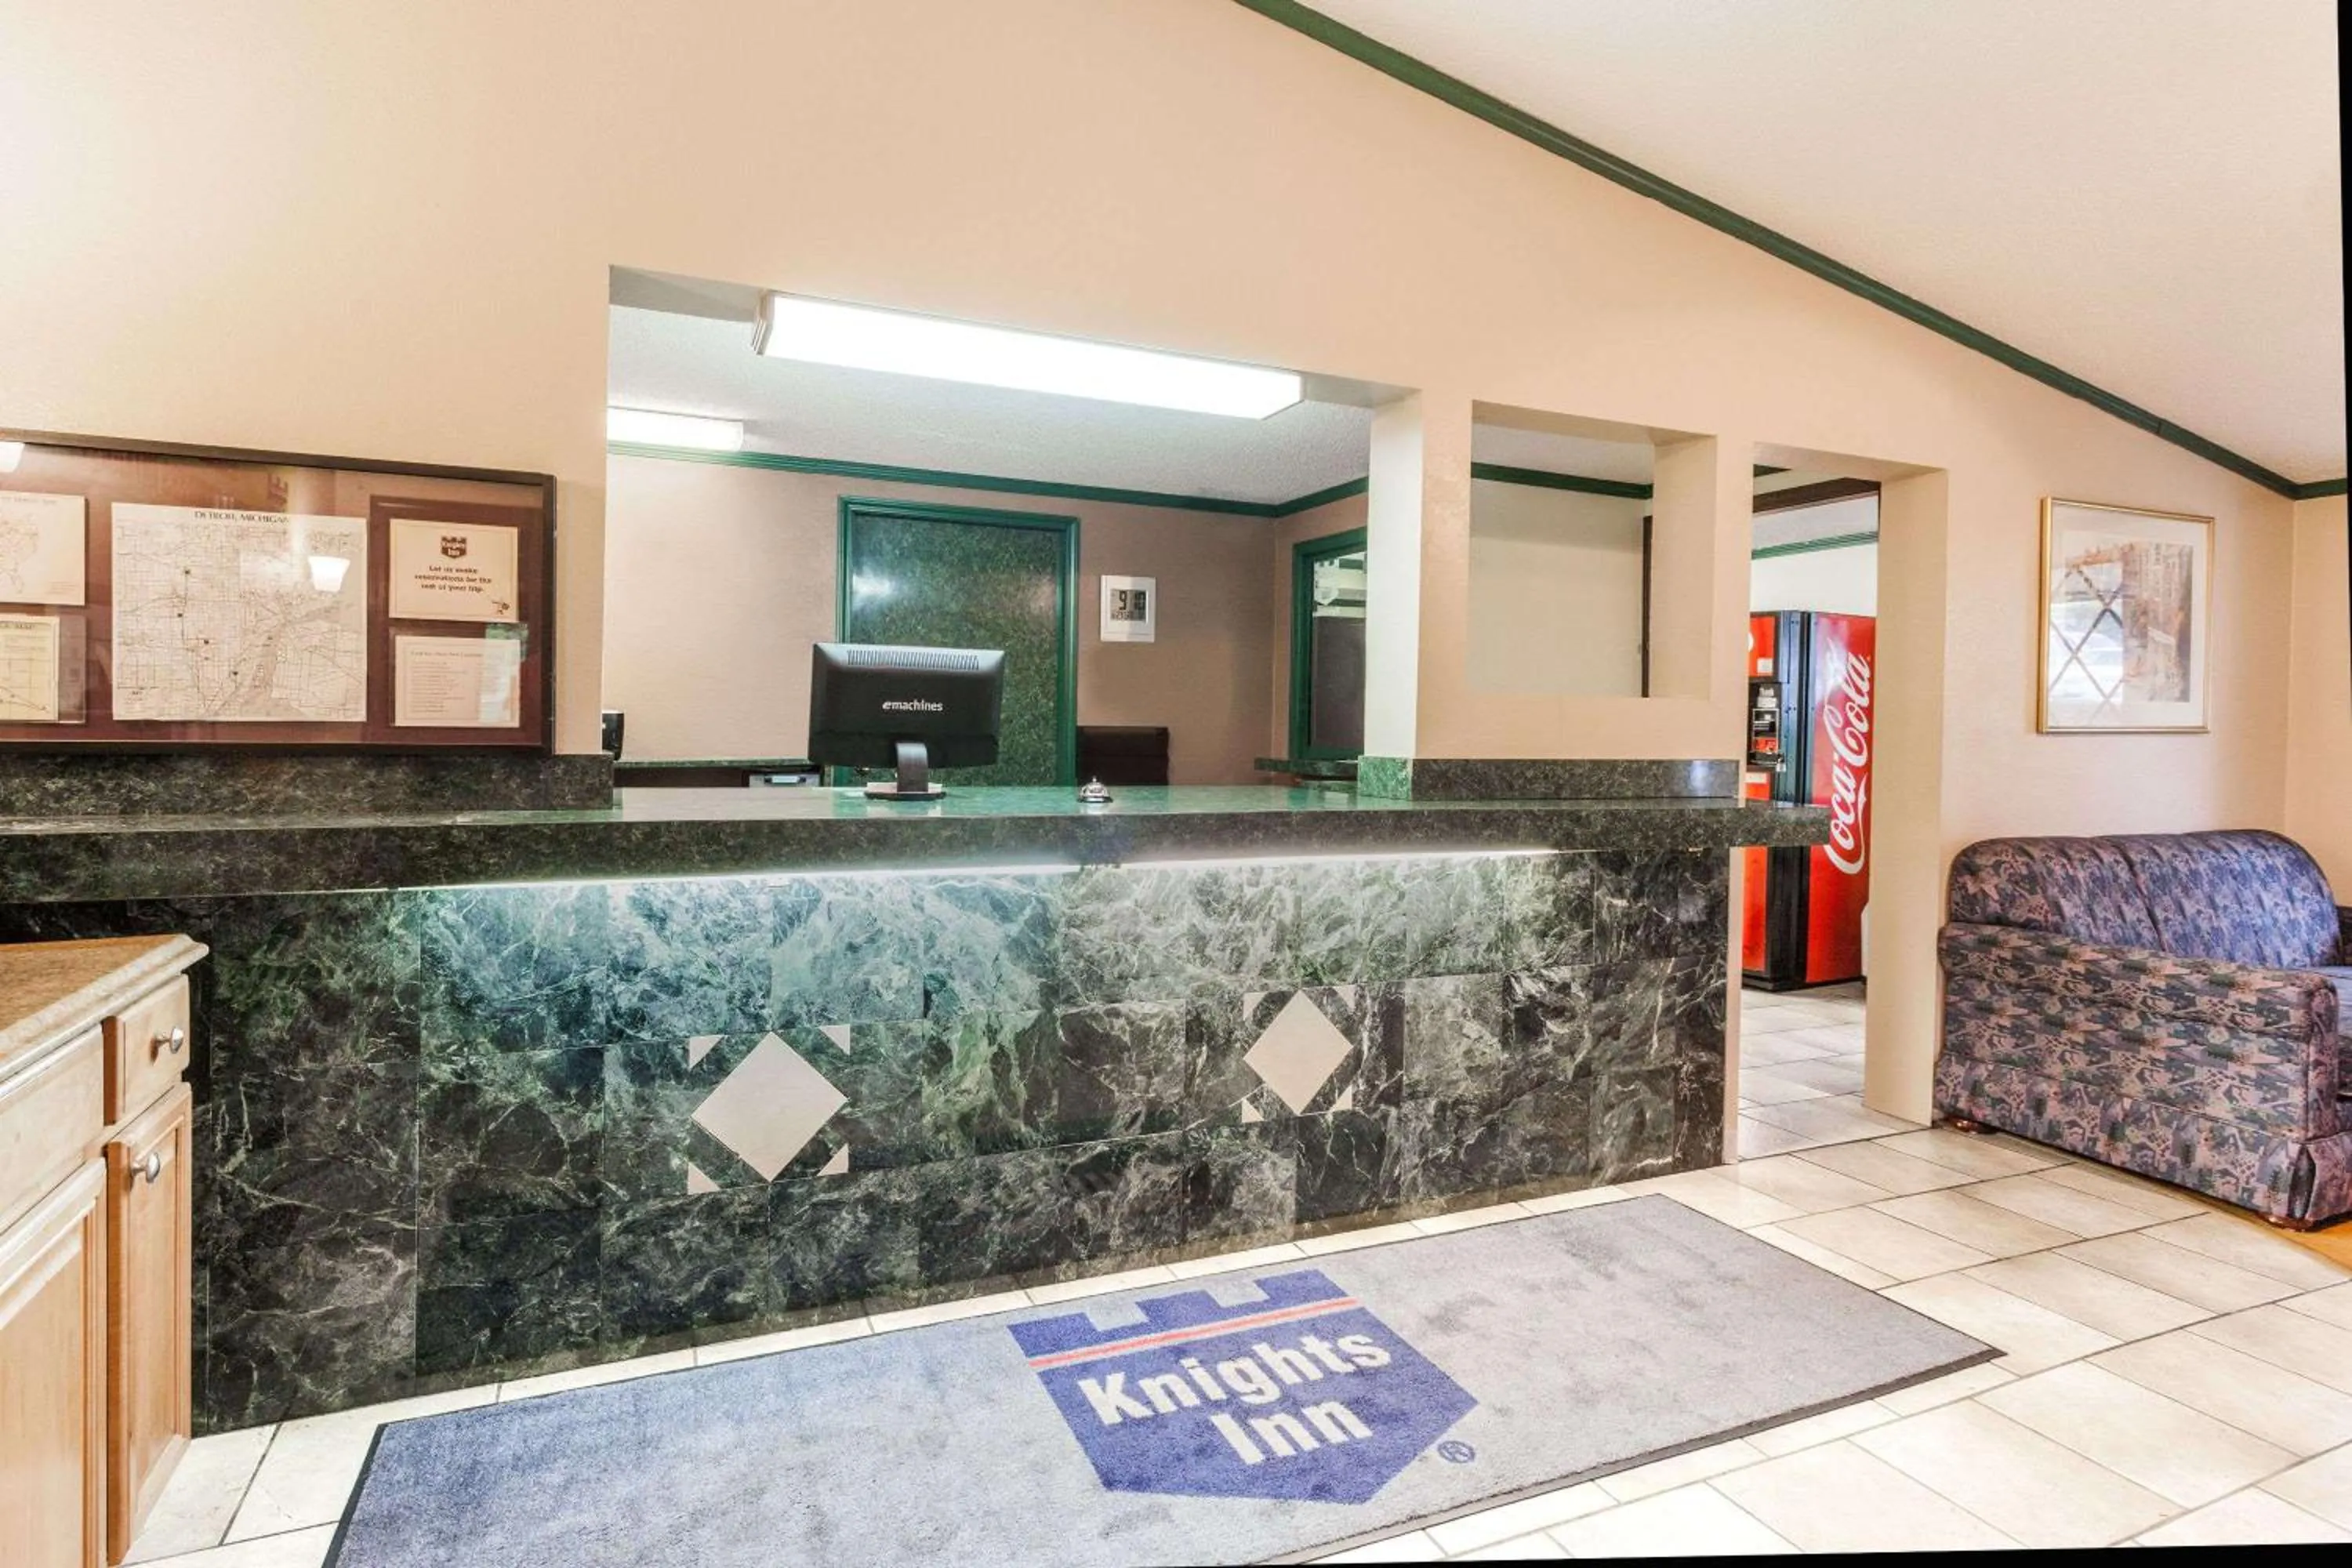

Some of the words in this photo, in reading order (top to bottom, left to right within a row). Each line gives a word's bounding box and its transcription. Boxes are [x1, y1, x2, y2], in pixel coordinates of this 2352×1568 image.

[882, 699, 943, 712] emachines
[1822, 639, 1871, 875] Coca-Cola
[1077, 1333, 1391, 1426] Knights
[1210, 1399, 1374, 1465] Inn
